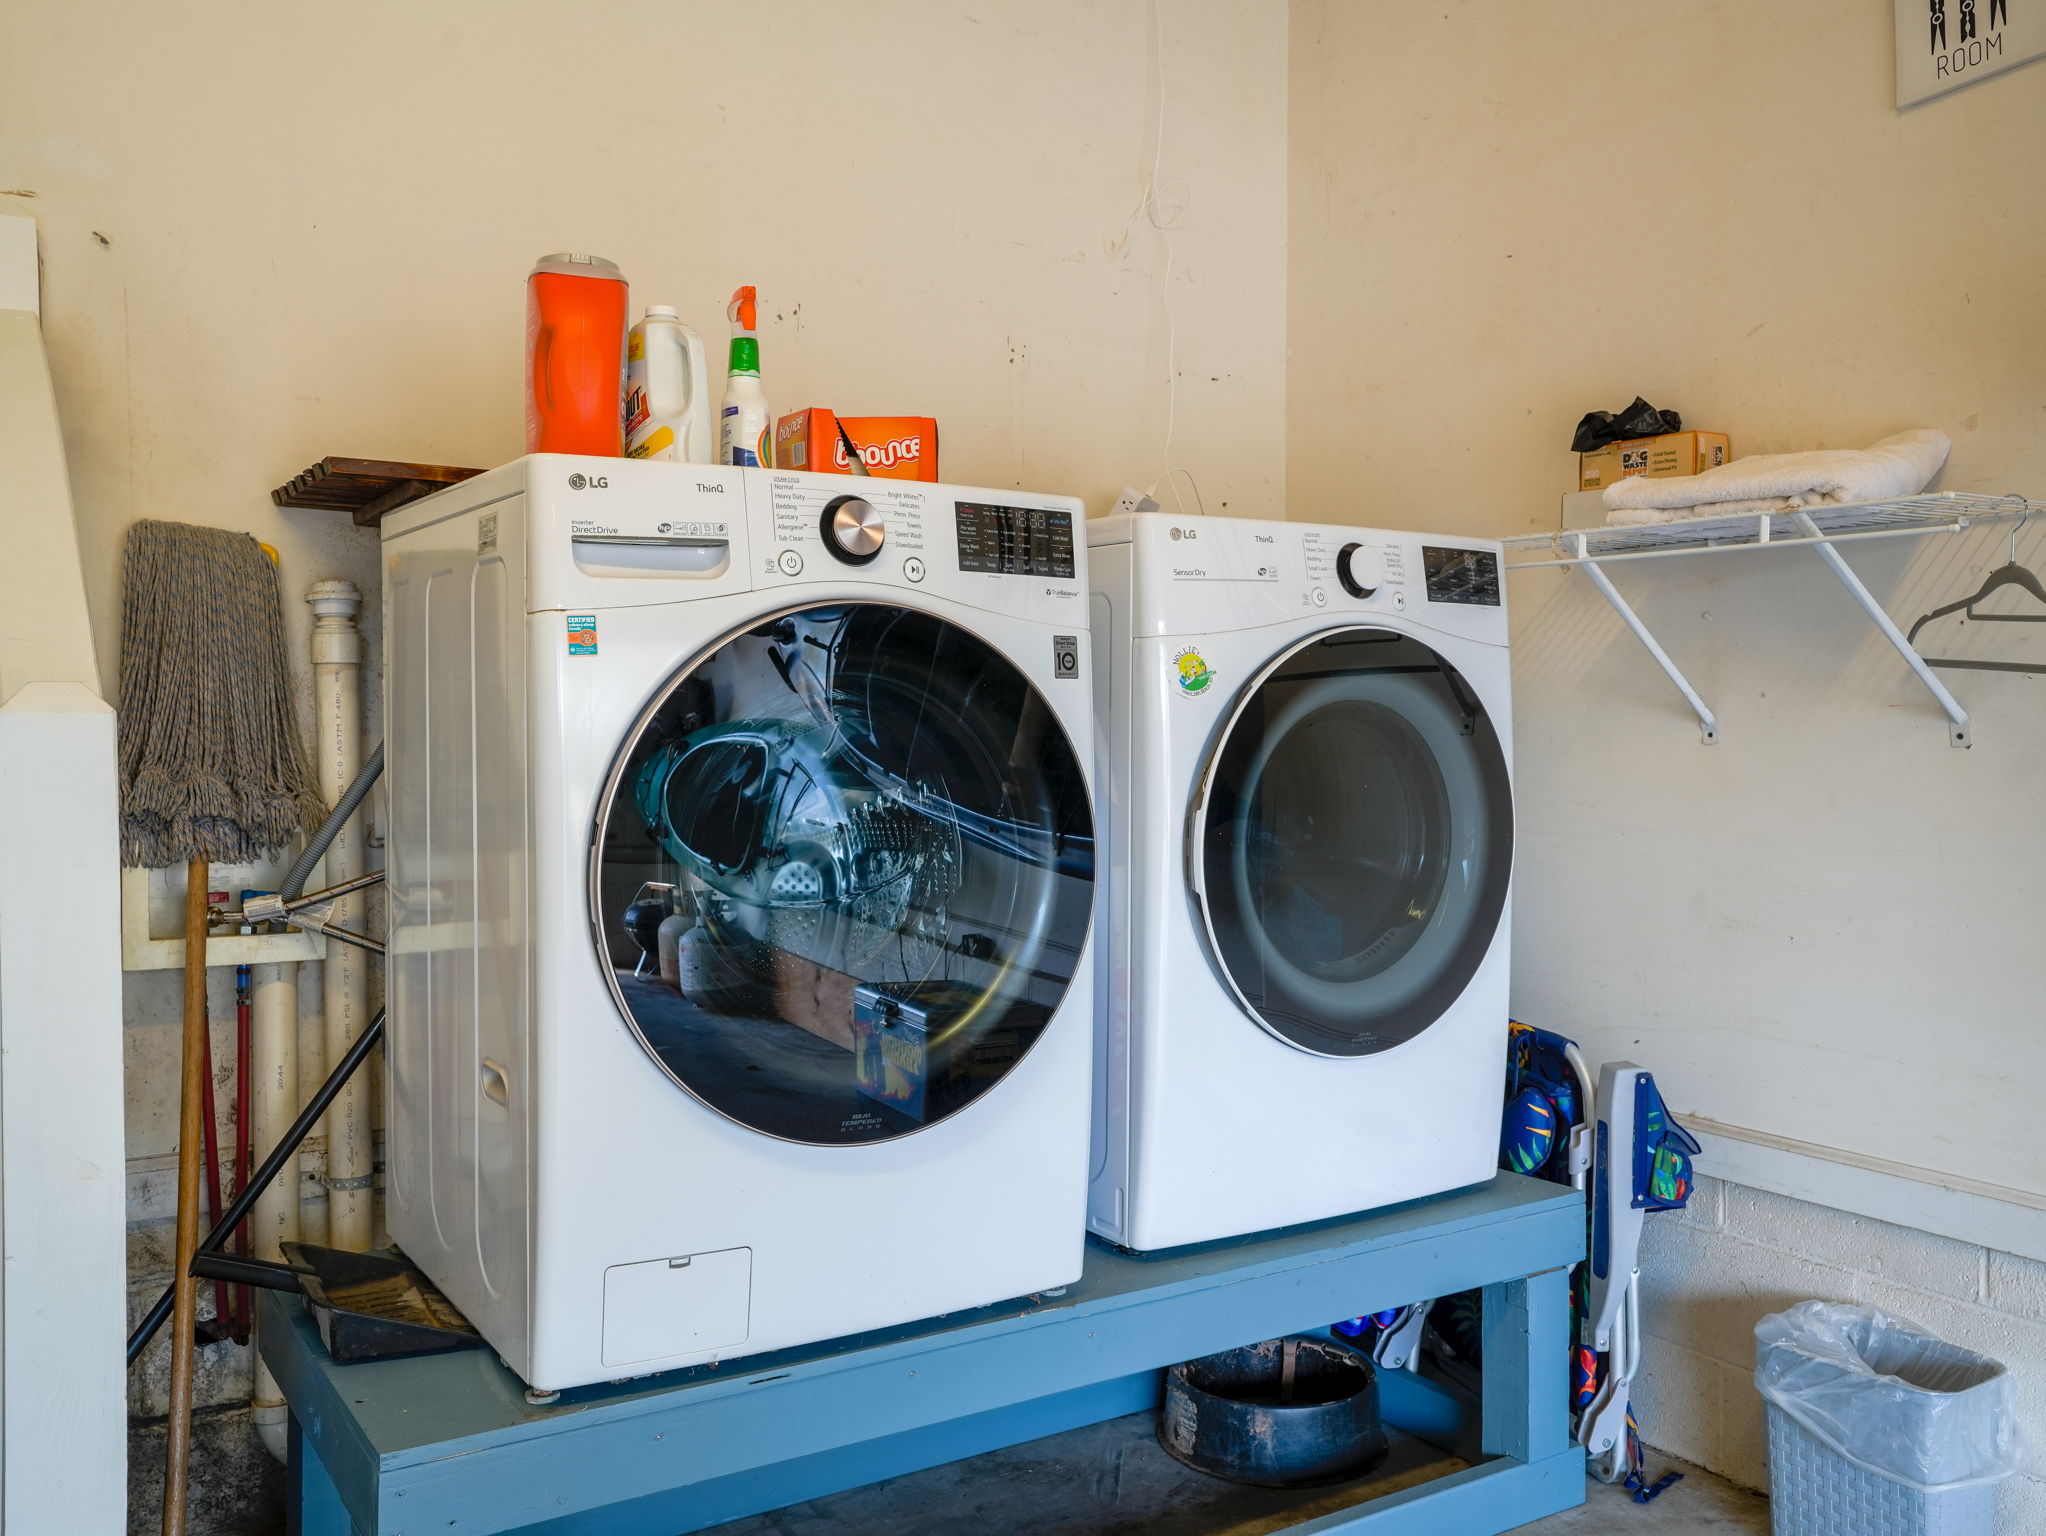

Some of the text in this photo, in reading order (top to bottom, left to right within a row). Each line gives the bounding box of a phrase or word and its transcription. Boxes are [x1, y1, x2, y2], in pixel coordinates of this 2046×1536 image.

[1937, 32, 2002, 80] ROOM
[779, 414, 803, 443] bounce
[834, 437, 920, 469] bounce
[1623, 461, 1648, 470] WASTE
[1623, 468, 1648, 476] DEPOT
[589, 477, 608, 489] LG
[696, 484, 724, 494] ThinQ
[792, 493, 805, 501] Duty
[888, 491, 902, 499] Bright
[775, 503, 798, 511] Bedding
[898, 501, 920, 510] Delicates
[776, 513, 798, 521] Sanitary
[908, 511, 921, 519] Press
[906, 521, 922, 529] Towels
[895, 530, 909, 538] Speed
[1183, 529, 1197, 540] LG
[1254, 536, 1274, 544] ThinQ
[895, 541, 924, 550] Downloaded
[1057, 652, 1075, 671] 10
[841, 1117, 882, 1126] TEMPERED
